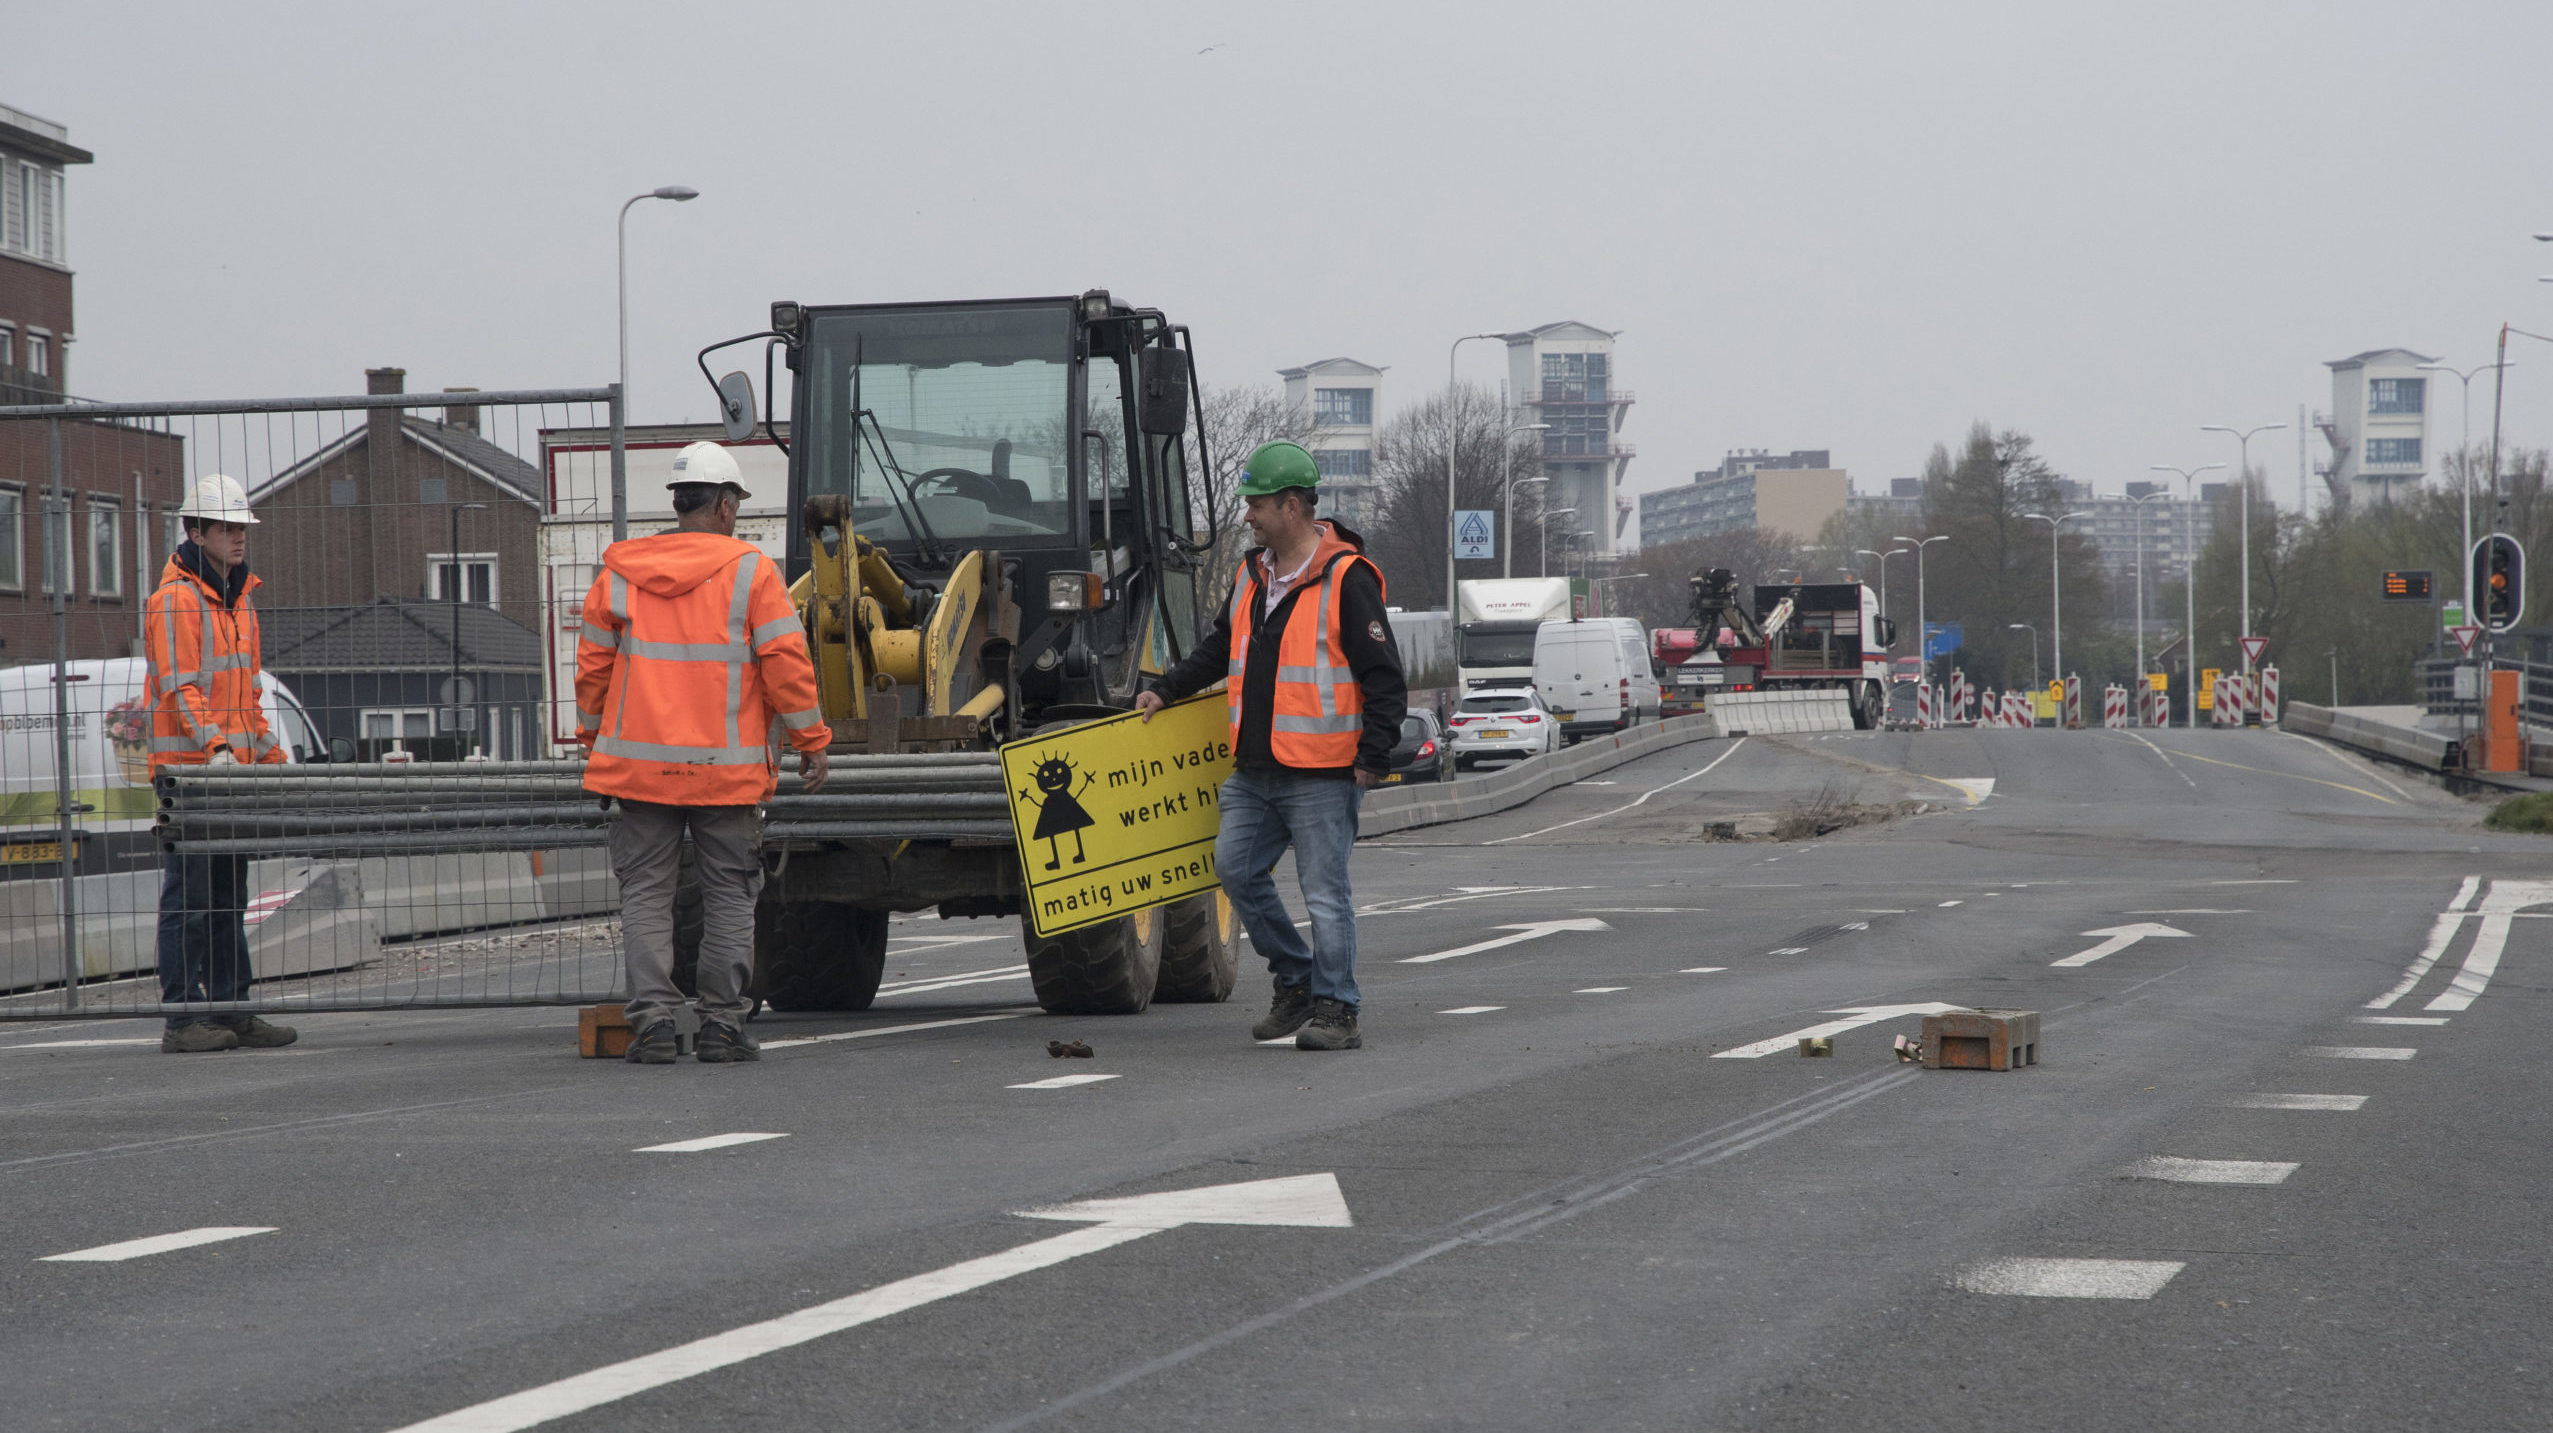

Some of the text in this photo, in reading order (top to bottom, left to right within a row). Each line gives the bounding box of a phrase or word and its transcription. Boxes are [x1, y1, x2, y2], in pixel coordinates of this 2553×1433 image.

[1108, 741, 1230, 788] mijn vade
[1119, 783, 1219, 827] werkt hi
[1044, 885, 1113, 917] matig
[1122, 874, 1152, 895] uw
